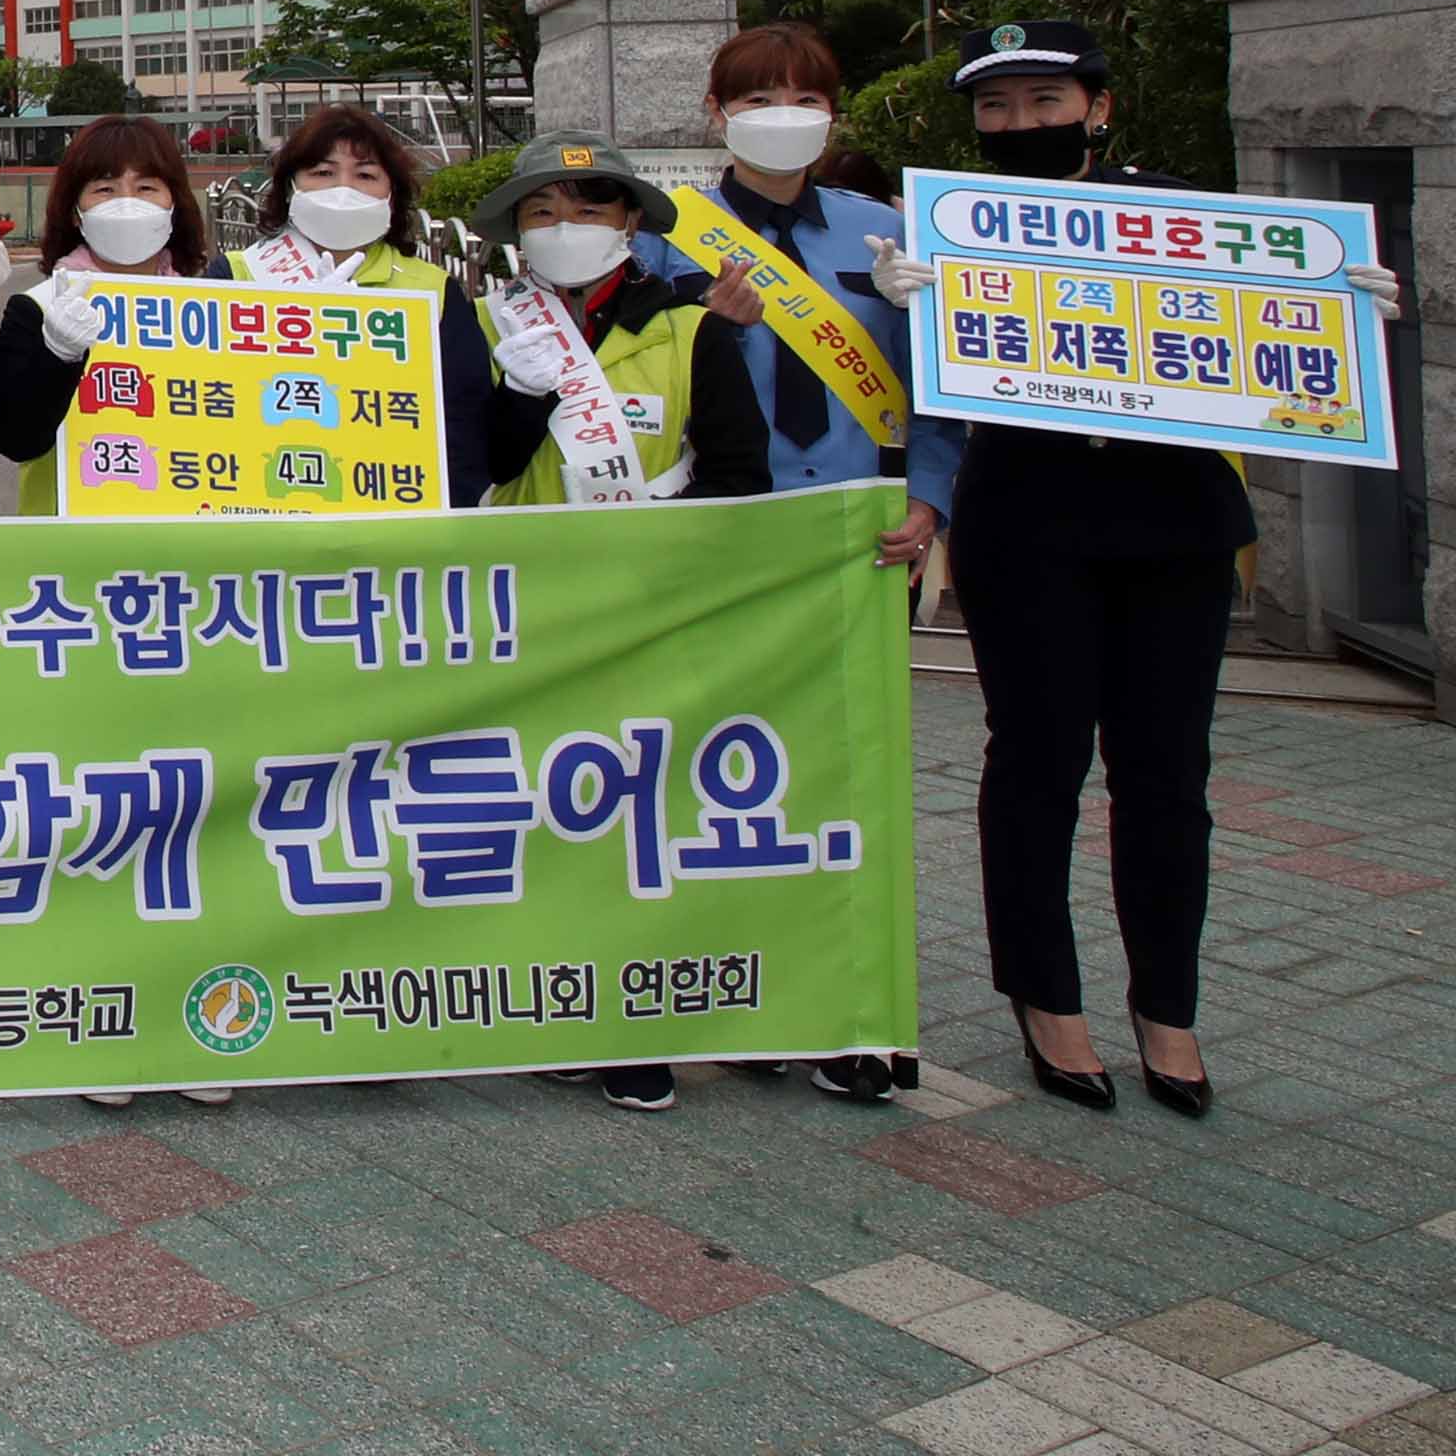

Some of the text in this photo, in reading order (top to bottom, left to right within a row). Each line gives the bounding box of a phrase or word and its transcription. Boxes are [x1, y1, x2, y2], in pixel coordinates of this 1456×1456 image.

[959, 270, 1321, 333] 1단 2쪽 3초 4고
[812, 320, 887, 397] 생명띠
[953, 310, 1339, 396] 멈춤 저쪽 동안 예방
[91, 368, 422, 430] 1단 멈춤 2쪽 저쪽
[1026, 382, 1155, 411] 인천광역시 동구
[92, 438, 426, 504] 3초 동안 4고 예방
[585, 455, 629, 480] 내
[250, 713, 862, 916] 만들어요.
[284, 964, 595, 1032] 녹색어머니회
[621, 951, 762, 1016] 연합회
